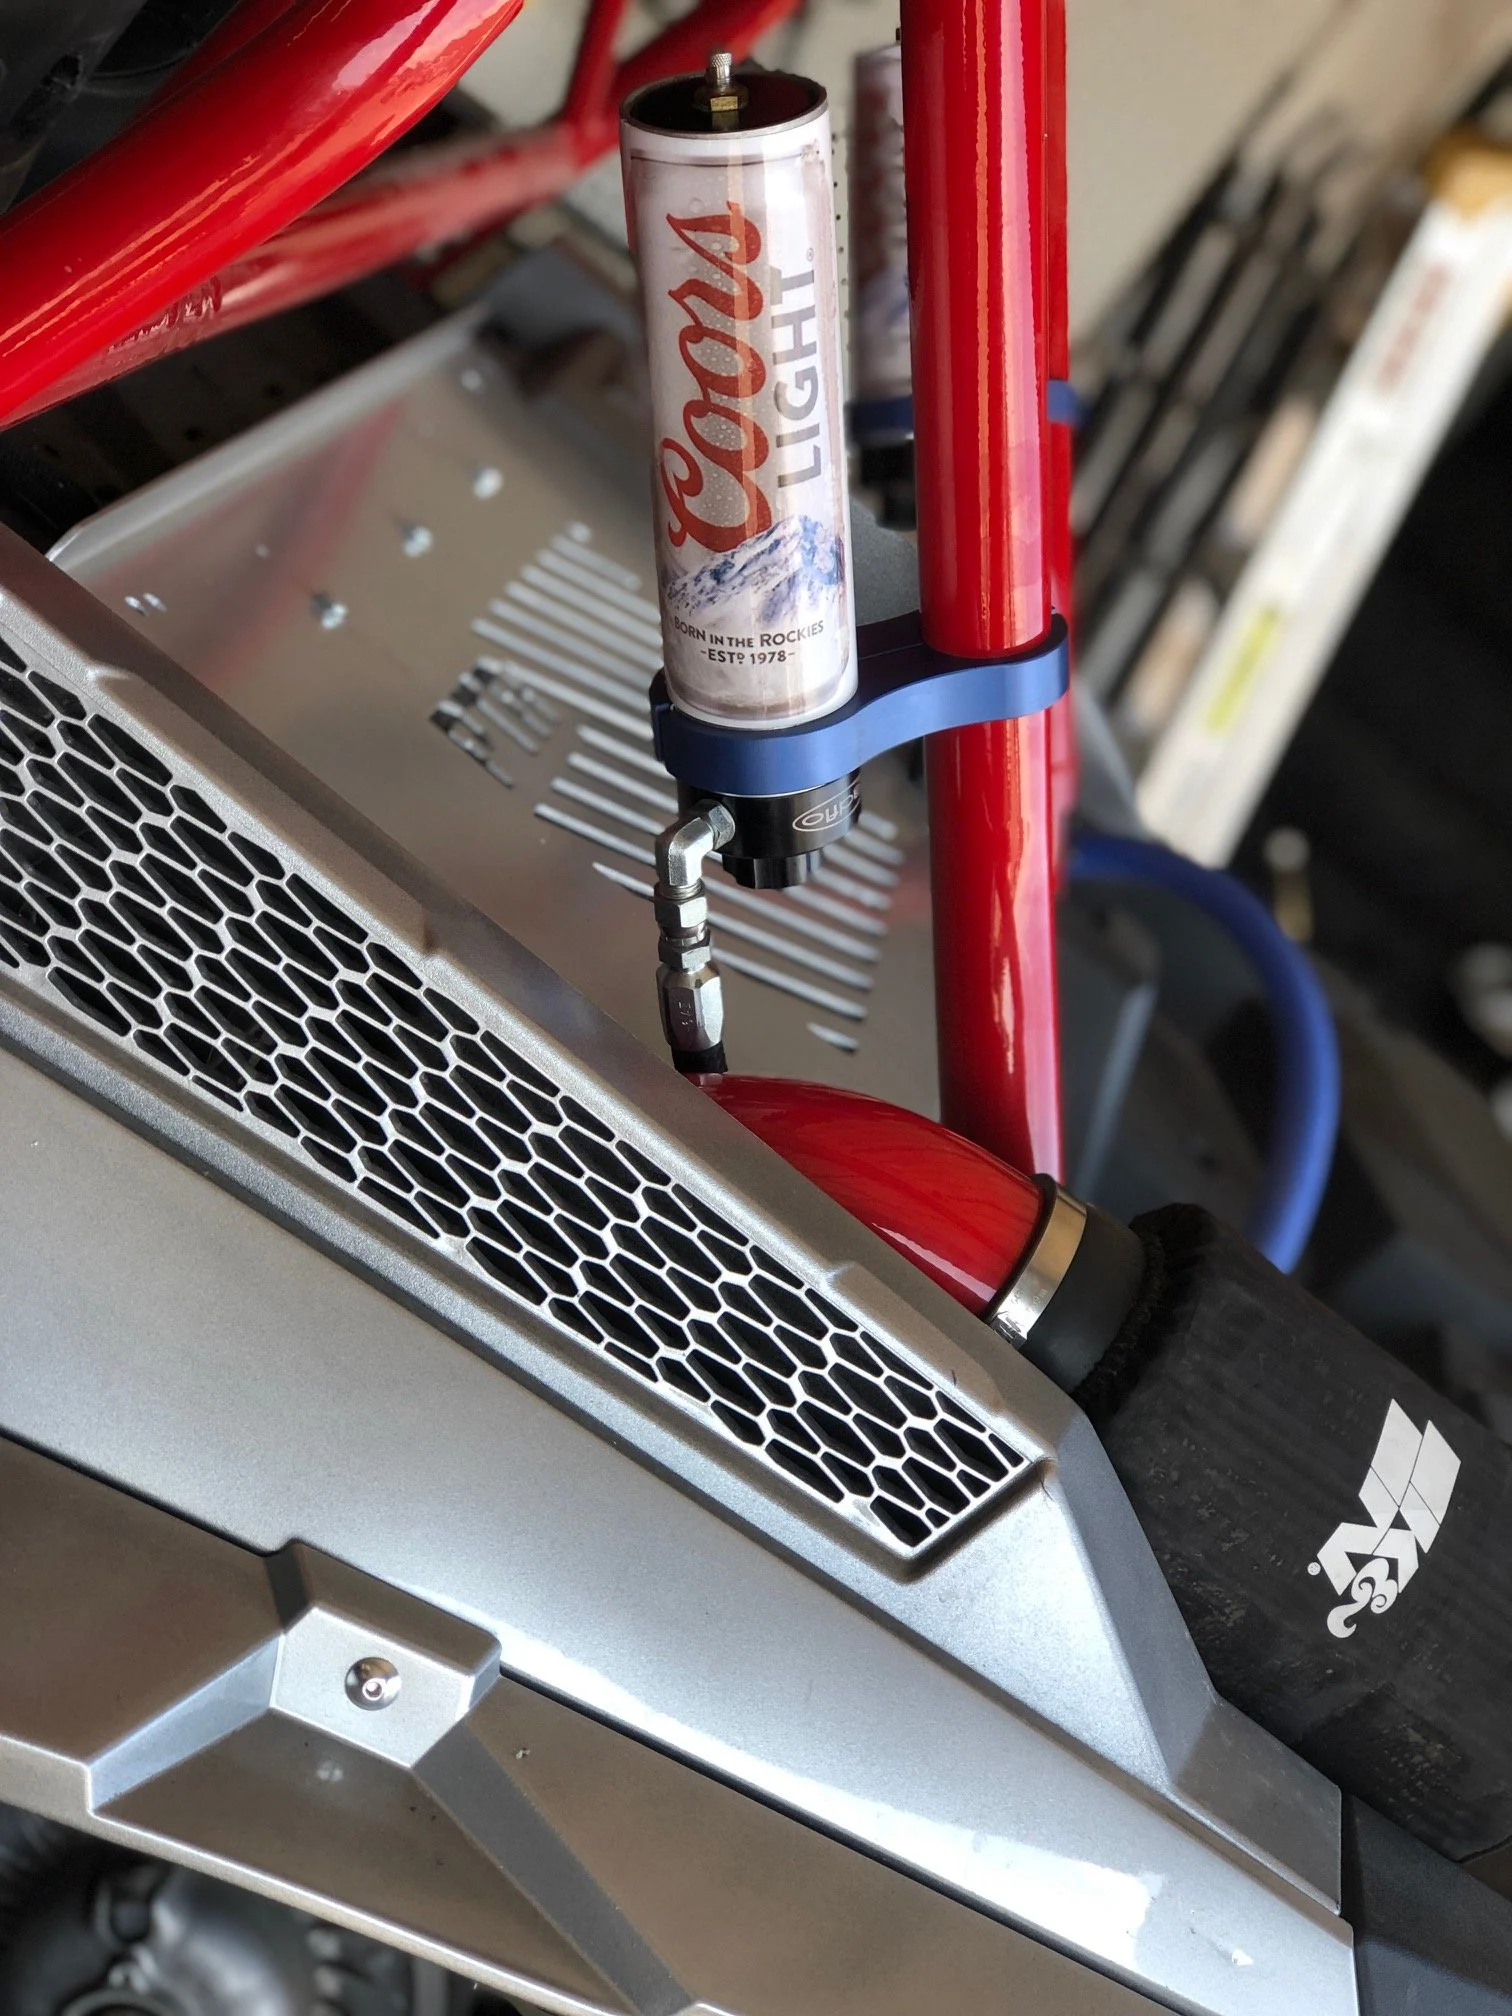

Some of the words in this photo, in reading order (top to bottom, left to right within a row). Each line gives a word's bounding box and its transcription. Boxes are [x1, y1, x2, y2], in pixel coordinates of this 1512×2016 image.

[659, 201, 772, 553] Coors
[771, 266, 822, 489] LIGHT
[674, 616, 706, 642] BORN
[709, 633, 724, 646] IN
[726, 637, 754, 648] THE
[760, 619, 824, 647] ROCKIES
